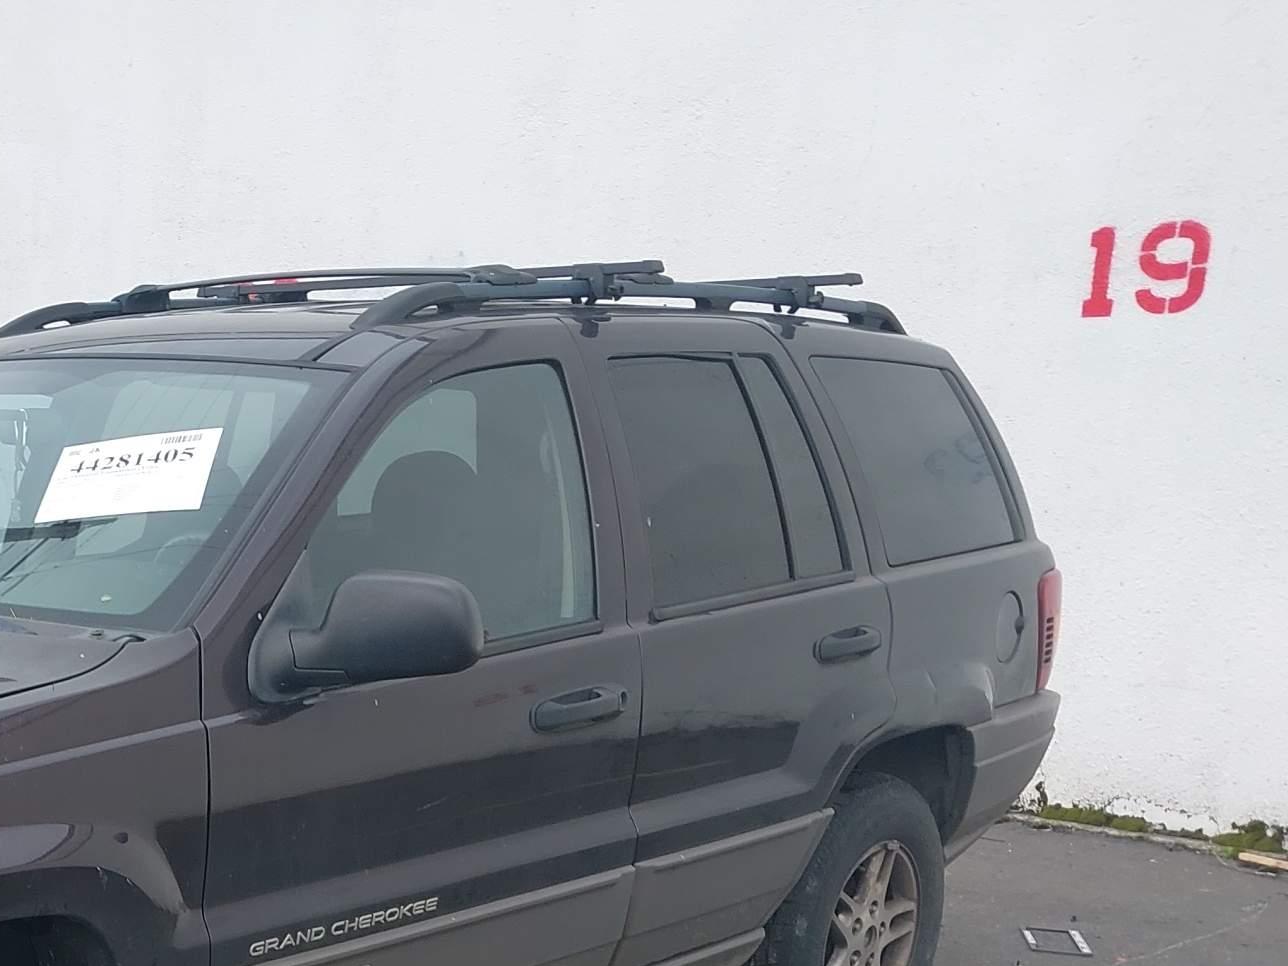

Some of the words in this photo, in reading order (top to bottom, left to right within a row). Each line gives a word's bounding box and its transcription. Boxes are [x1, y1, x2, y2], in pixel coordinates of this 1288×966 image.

[1081, 219, 1211, 317] 19
[70, 446, 196, 474] 44281405
[249, 925, 326, 957] GRAND
[331, 896, 439, 936] CHEROKEE
